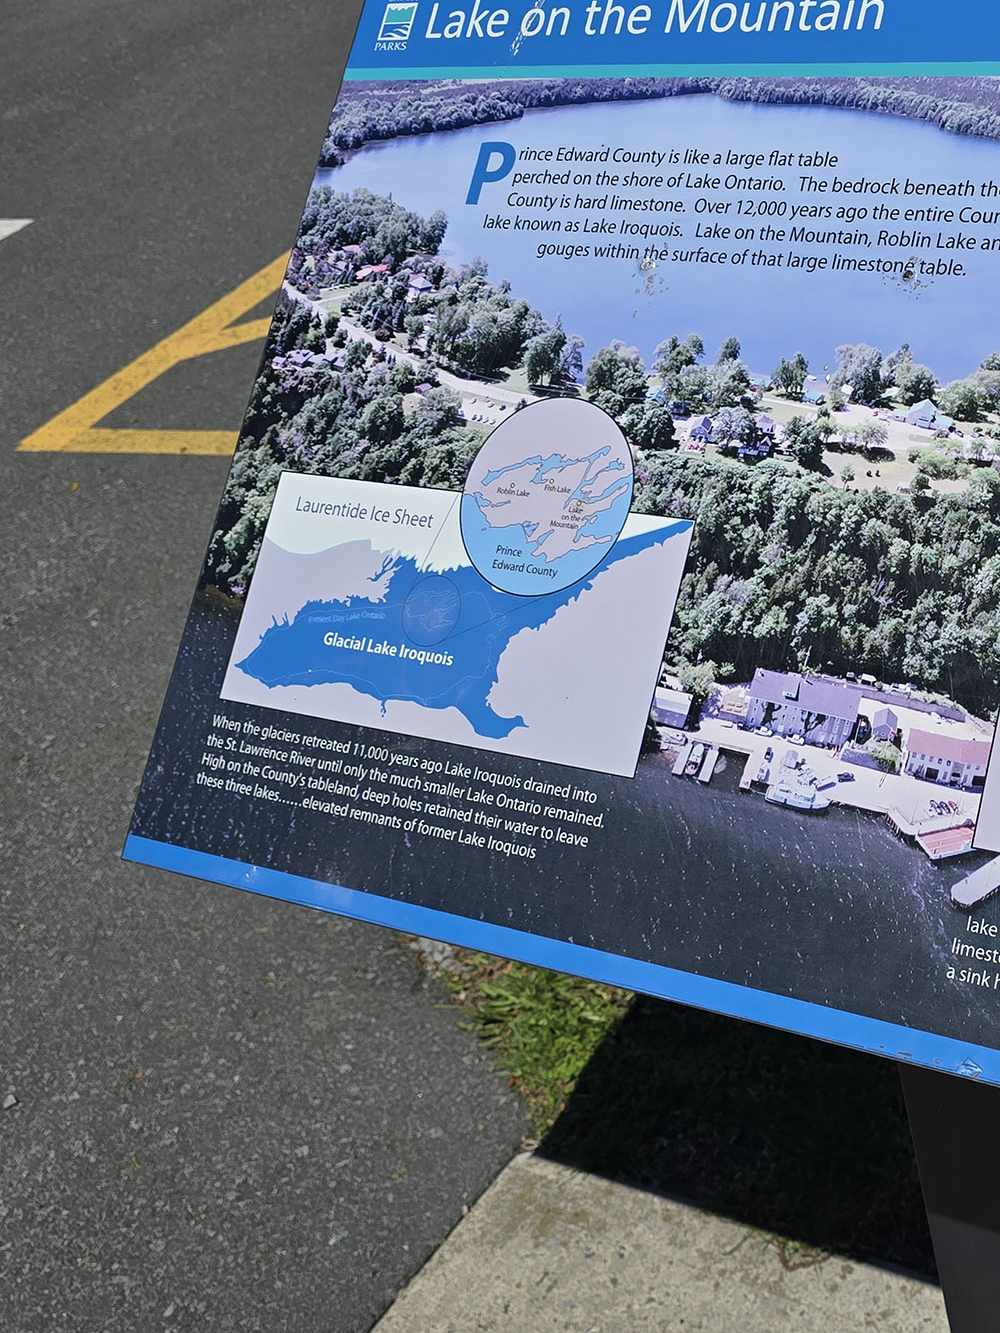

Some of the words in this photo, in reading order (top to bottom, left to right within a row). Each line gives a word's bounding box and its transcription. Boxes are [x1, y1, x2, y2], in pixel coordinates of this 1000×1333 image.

[425, 0, 509, 38] Lake
[520, 5, 570, 37] on
[374, 42, 407, 51] PARKS
[511, 169, 571, 187] perched
[573, 174, 592, 185] on
[596, 171, 619, 186] the
[622, 171, 663, 187] shore
[667, 172, 685, 188] of
[685, 173, 721, 189] Lake
[724, 174, 786, 191] Ontario.
[799, 176, 828, 192] The
[831, 177, 900, 194] bedrock
[903, 178, 975, 196] beneath
[483, 214, 511, 230] lake
[513, 215, 561, 231] known
[564, 221, 580, 232] as
[583, 218, 617, 234] Lake
[620, 220, 683, 239] Iroquois.
[695, 223, 731, 239] Lake
[734, 228, 755, 240] on
[759, 225, 786, 241] the
[789, 226, 872, 248] Mountain,
[877, 230, 931, 248] Roblin
[936, 232, 976, 250] Lake
[296, 496, 367, 519] Laurentide
[370, 506, 390, 522] Ice
[393, 509, 434, 528] Sheet
[496, 545, 522, 557] Prince
[492, 560, 524, 573] Edward
[527, 564, 558, 578] County
[323, 631, 366, 651] Glacial
[366, 639, 397, 656] Lake
[399, 644, 453, 666] Iroquois
[213, 714, 241, 732] When
[243, 721, 260, 735] the
[261, 726, 300, 743] glaciers
[302, 735, 352, 753] retreated
[353, 743, 389, 761] 11,000
[389, 753, 419, 768] years
[420, 759, 443, 773] ago
[444, 761, 472, 778] Lake
[473, 766, 522, 788] Iroquois
[523, 777, 571, 798] drained
[572, 786, 597, 804] into
[207, 733, 224, 748] the
[224, 737, 237, 751] St.
[239, 740, 288, 762] Lawrence
[289, 750, 316, 767] River
[317, 759, 343, 773] until
[343, 766, 368, 781] only
[369, 767, 388, 783] the
[389, 775, 421, 790] much
[423, 781, 466, 799] smaller
[466, 787, 494, 805] Lake
[496, 794, 541, 815] Ontario
[543, 806, 604, 828] remained.
[201, 752, 226, 771] High
[227, 762, 241, 773] on
[242, 761, 260, 777] the
[261, 766, 306, 789] County's
[306, 776, 360, 801] tableland,
[362, 787, 390, 807] deep
[392, 792, 422, 812] holes
[424, 804, 473, 823] retained
[474, 811, 503, 829] their
[504, 820, 539, 836] water
[540, 826, 553, 840] to
[555, 827, 588, 847] leave
[966, 915, 998, 937] lake
[946, 967, 955, 980] a
[959, 968, 991, 988] sink
